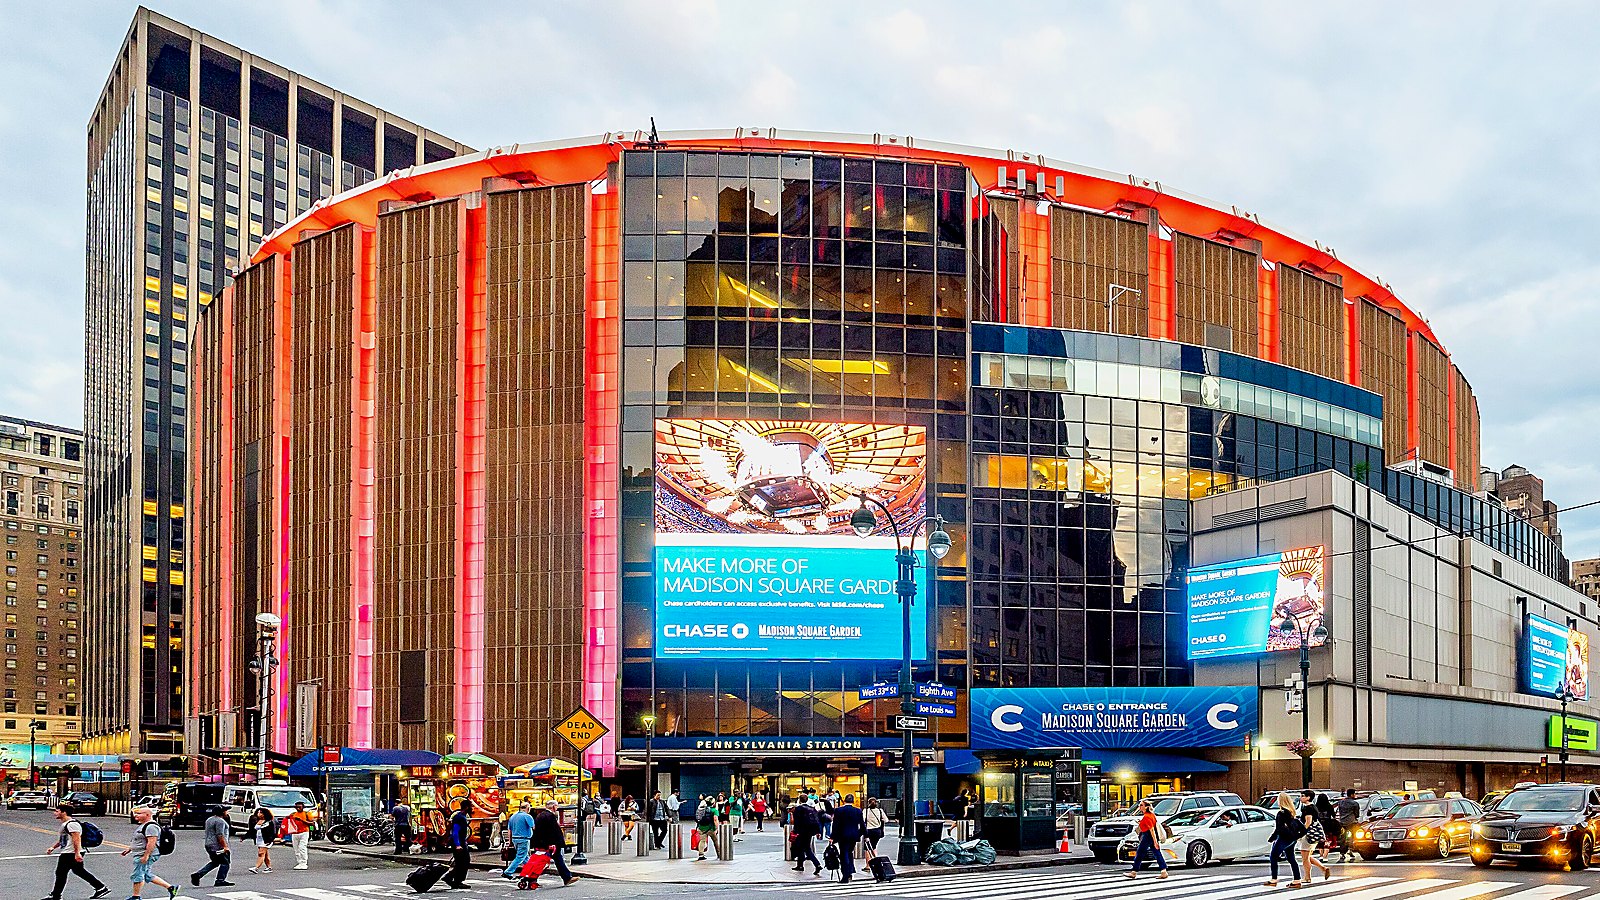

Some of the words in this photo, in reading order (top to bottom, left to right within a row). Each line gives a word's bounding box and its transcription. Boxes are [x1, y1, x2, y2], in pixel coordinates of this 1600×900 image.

[663, 557, 716, 573] MAKE
[721, 557, 777, 574] MORE
[781, 558, 809, 575] OF
[663, 577, 753, 593] MADISON
[758, 577, 835, 597] SQUARE
[839, 579, 899, 595] GARDE
[1191, 593, 1207, 601] MAKE
[1191, 600, 1218, 608] MADISON
[1219, 596, 1243, 604] SQUARE
[1245, 591, 1270, 600] GARDEN
[663, 624, 729, 638] CHASE
[758, 624, 795, 637] MADISON
[797, 624, 828, 638] SQUARE
[1191, 636, 1218, 645] CHASE
[862, 687, 877, 697] West
[877, 686, 889, 696] 33rd
[890, 686, 896, 694] St
[919, 685, 940, 697] Eighth
[941, 688, 953, 697] Ave
[920, 705, 928, 713] Joe
[930, 705, 944, 714] Louis
[1062, 703, 1095, 711] CHASE
[1108, 702, 1168, 711] ENTRANCE
[990, 704, 1024, 732] C
[1042, 712, 1093, 729] MADISON
[1096, 712, 1139, 729] SQUARE
[1206, 702, 1239, 730] C
[567, 721, 595, 730] DEAD
[570, 731, 591, 740] END
[696, 740, 801, 750] PENNSYLVANIA
[806, 740, 862, 750] STATION
[412, 766, 421, 776] HOT
[422, 766, 432, 776] DOG
[447, 766, 485, 777] ALAFEL
[1055, 771, 1073, 780] GARDEN
